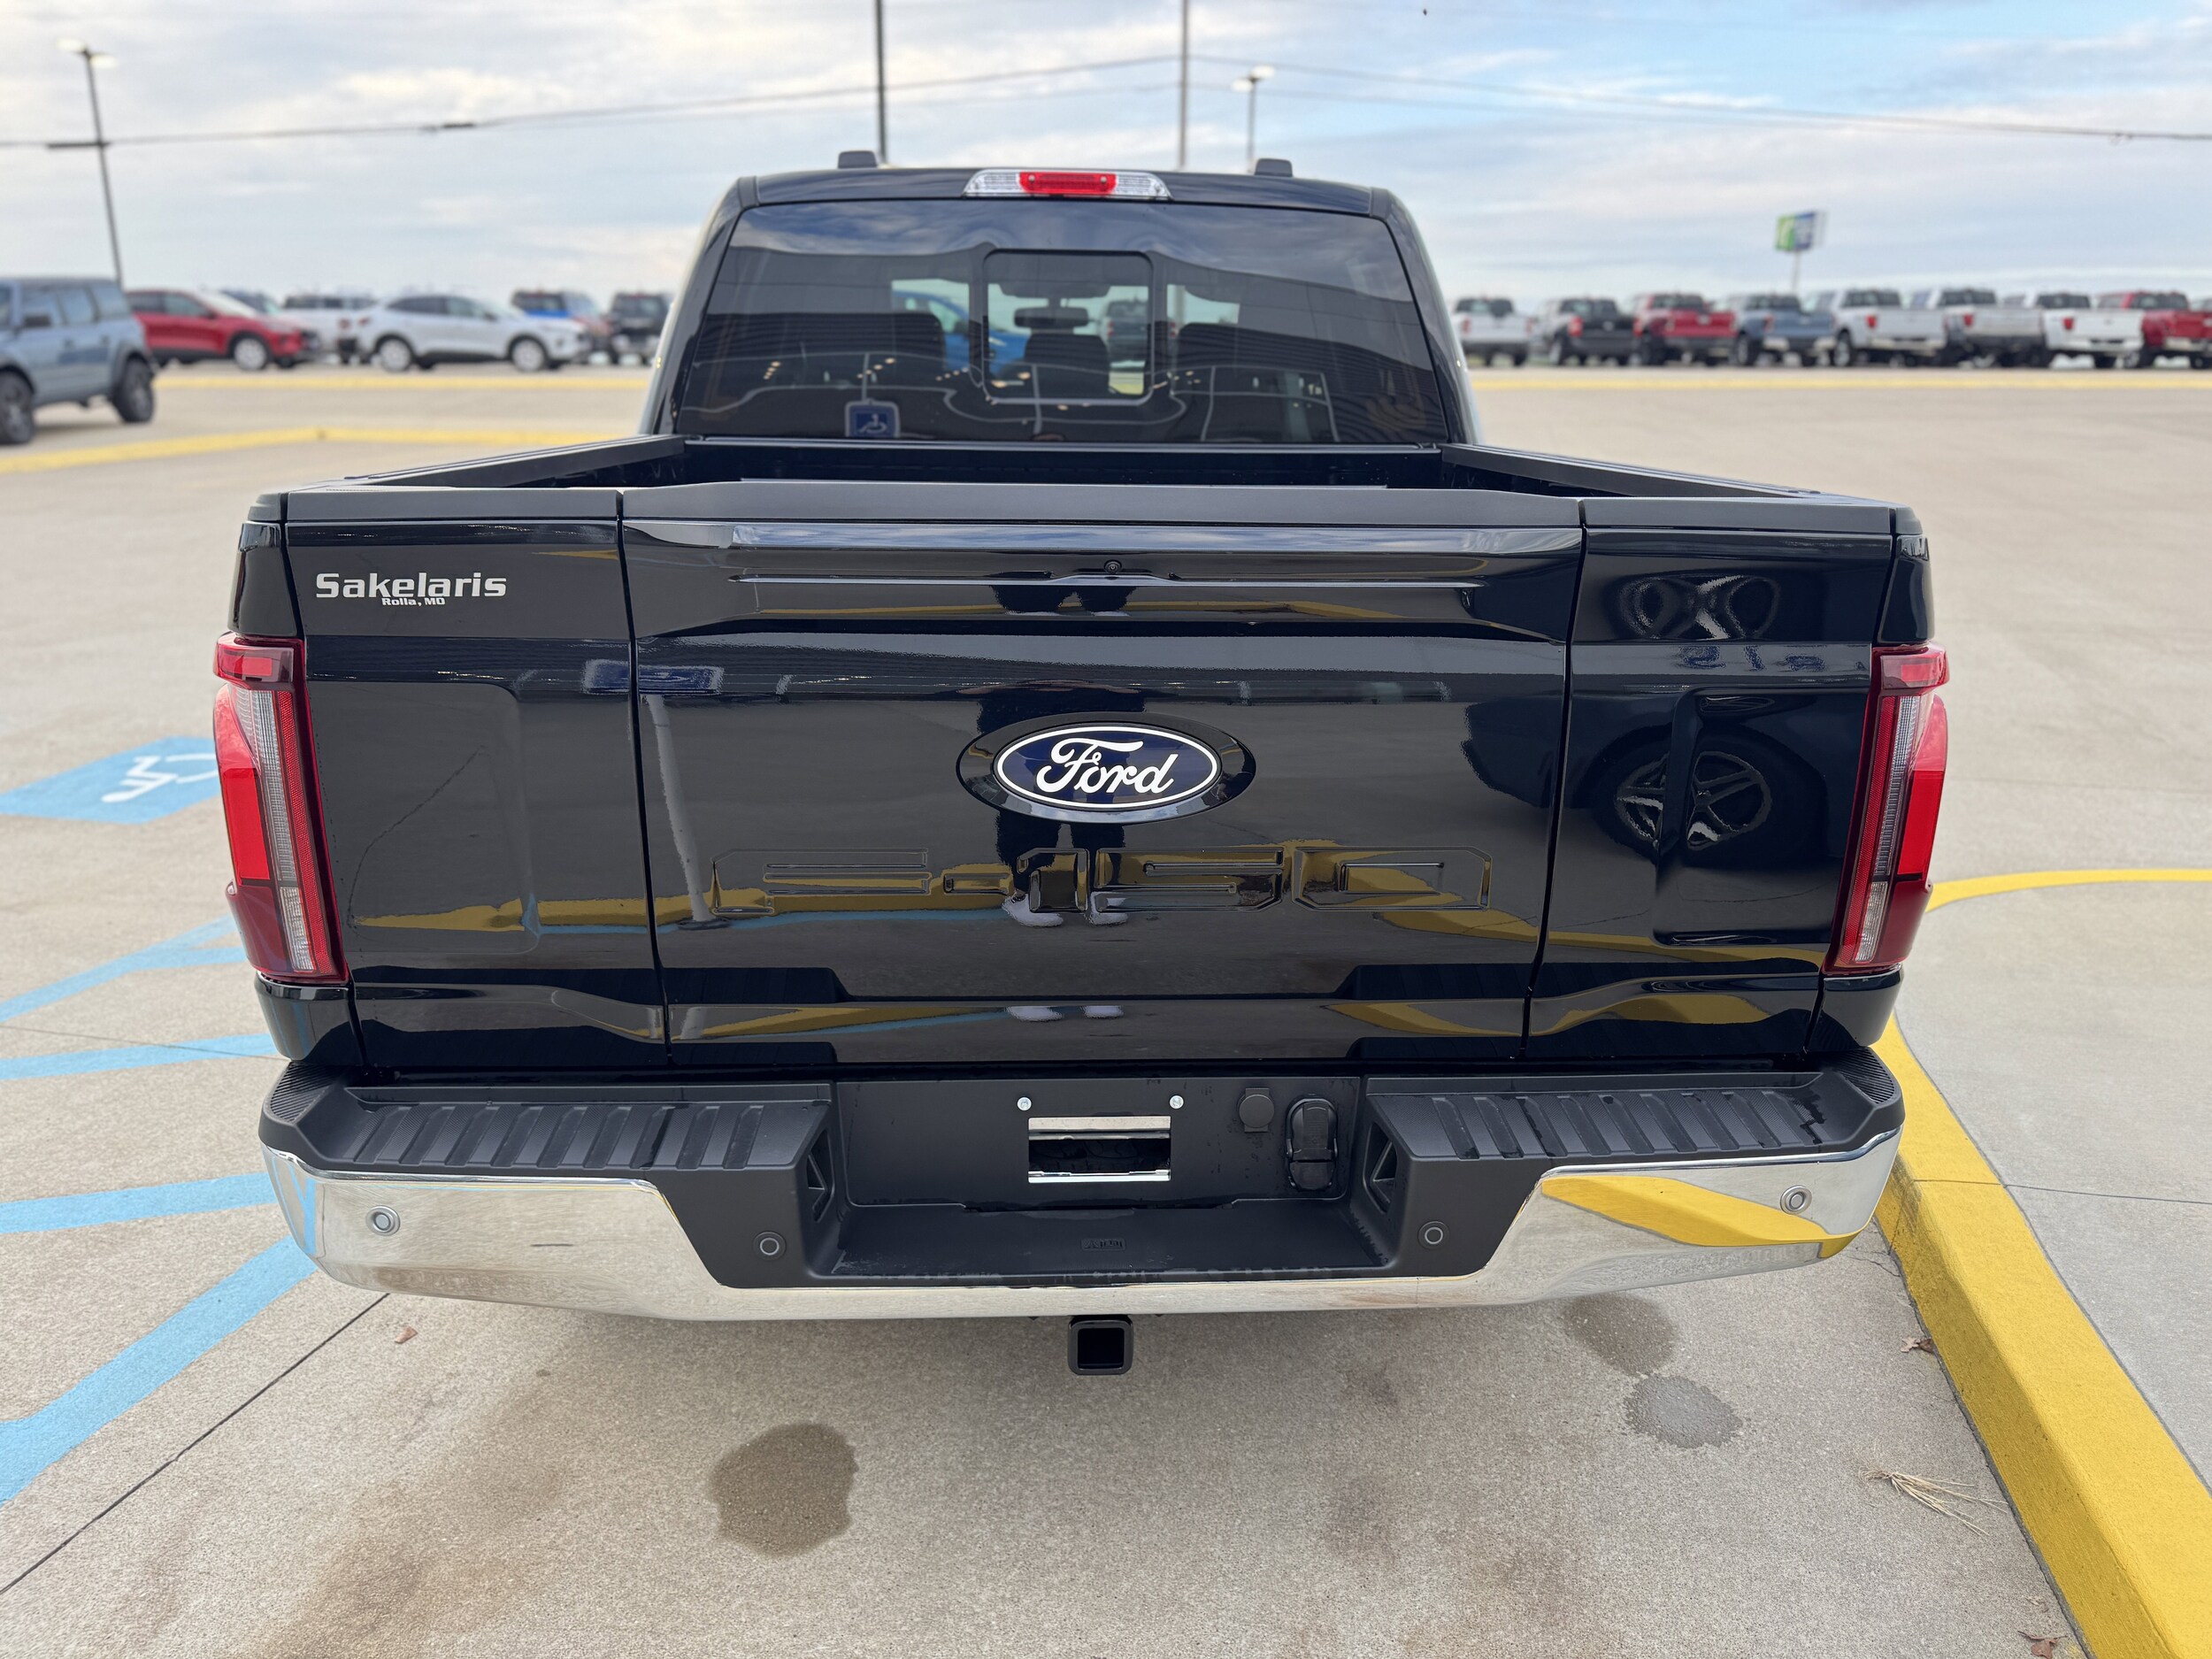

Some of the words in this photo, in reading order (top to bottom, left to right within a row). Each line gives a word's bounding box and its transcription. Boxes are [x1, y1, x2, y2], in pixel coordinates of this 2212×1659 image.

[316, 572, 507, 598] Sakelaris
[381, 597, 422, 607] Rolla,
[425, 597, 446, 606] MO
[1036, 737, 1179, 794] Ford
[710, 846, 1494, 915] F-150
